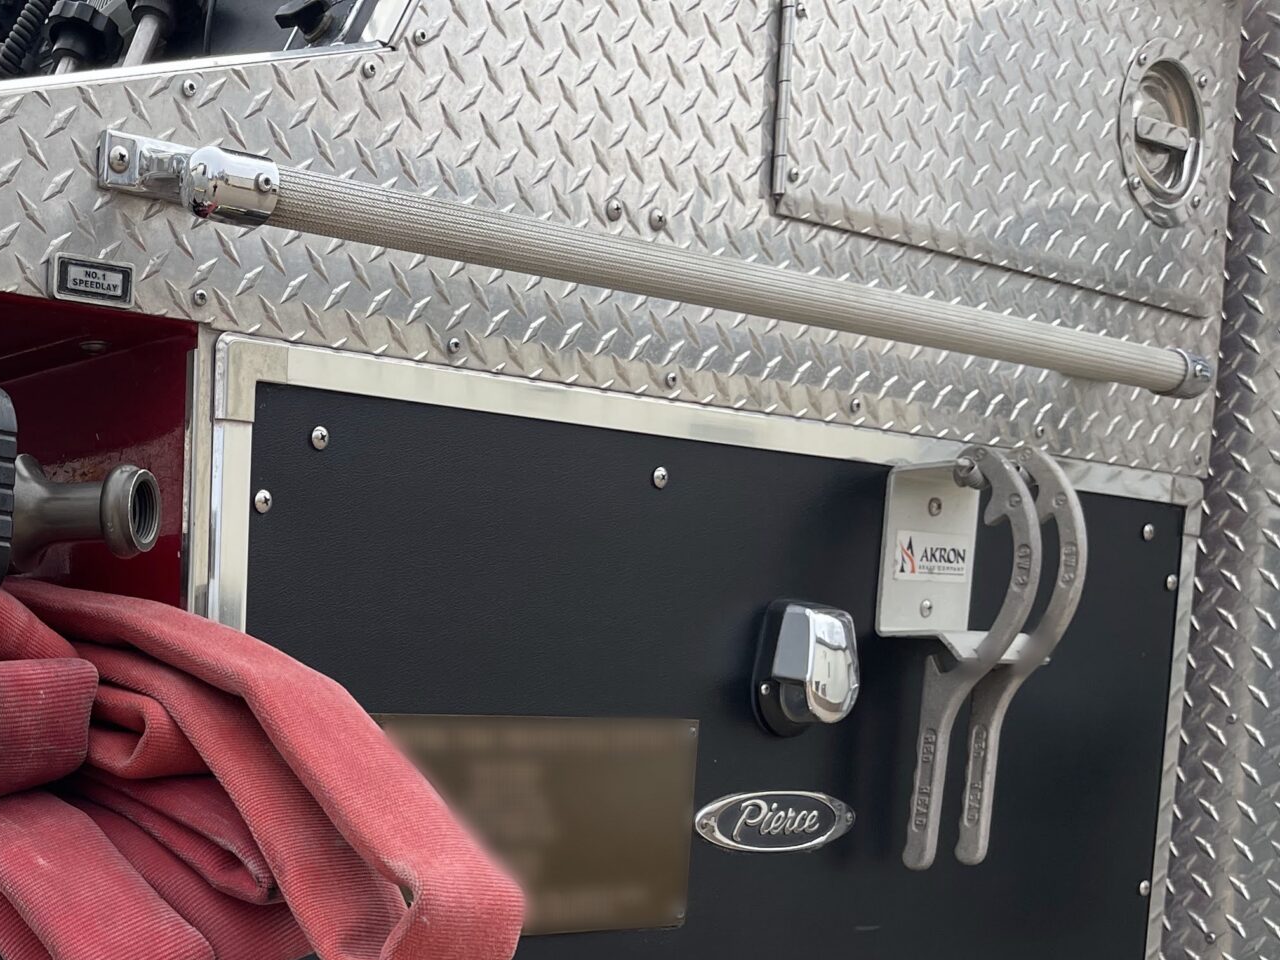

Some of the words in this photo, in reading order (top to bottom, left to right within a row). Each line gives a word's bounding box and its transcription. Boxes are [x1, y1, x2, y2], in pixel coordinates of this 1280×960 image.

[84, 270, 100, 281] NO.
[102, 273, 106, 281] 1
[72, 278, 118, 292] SPEEDLAY
[920, 546, 966, 564] AKRON
[732, 799, 820, 841] Pierce
